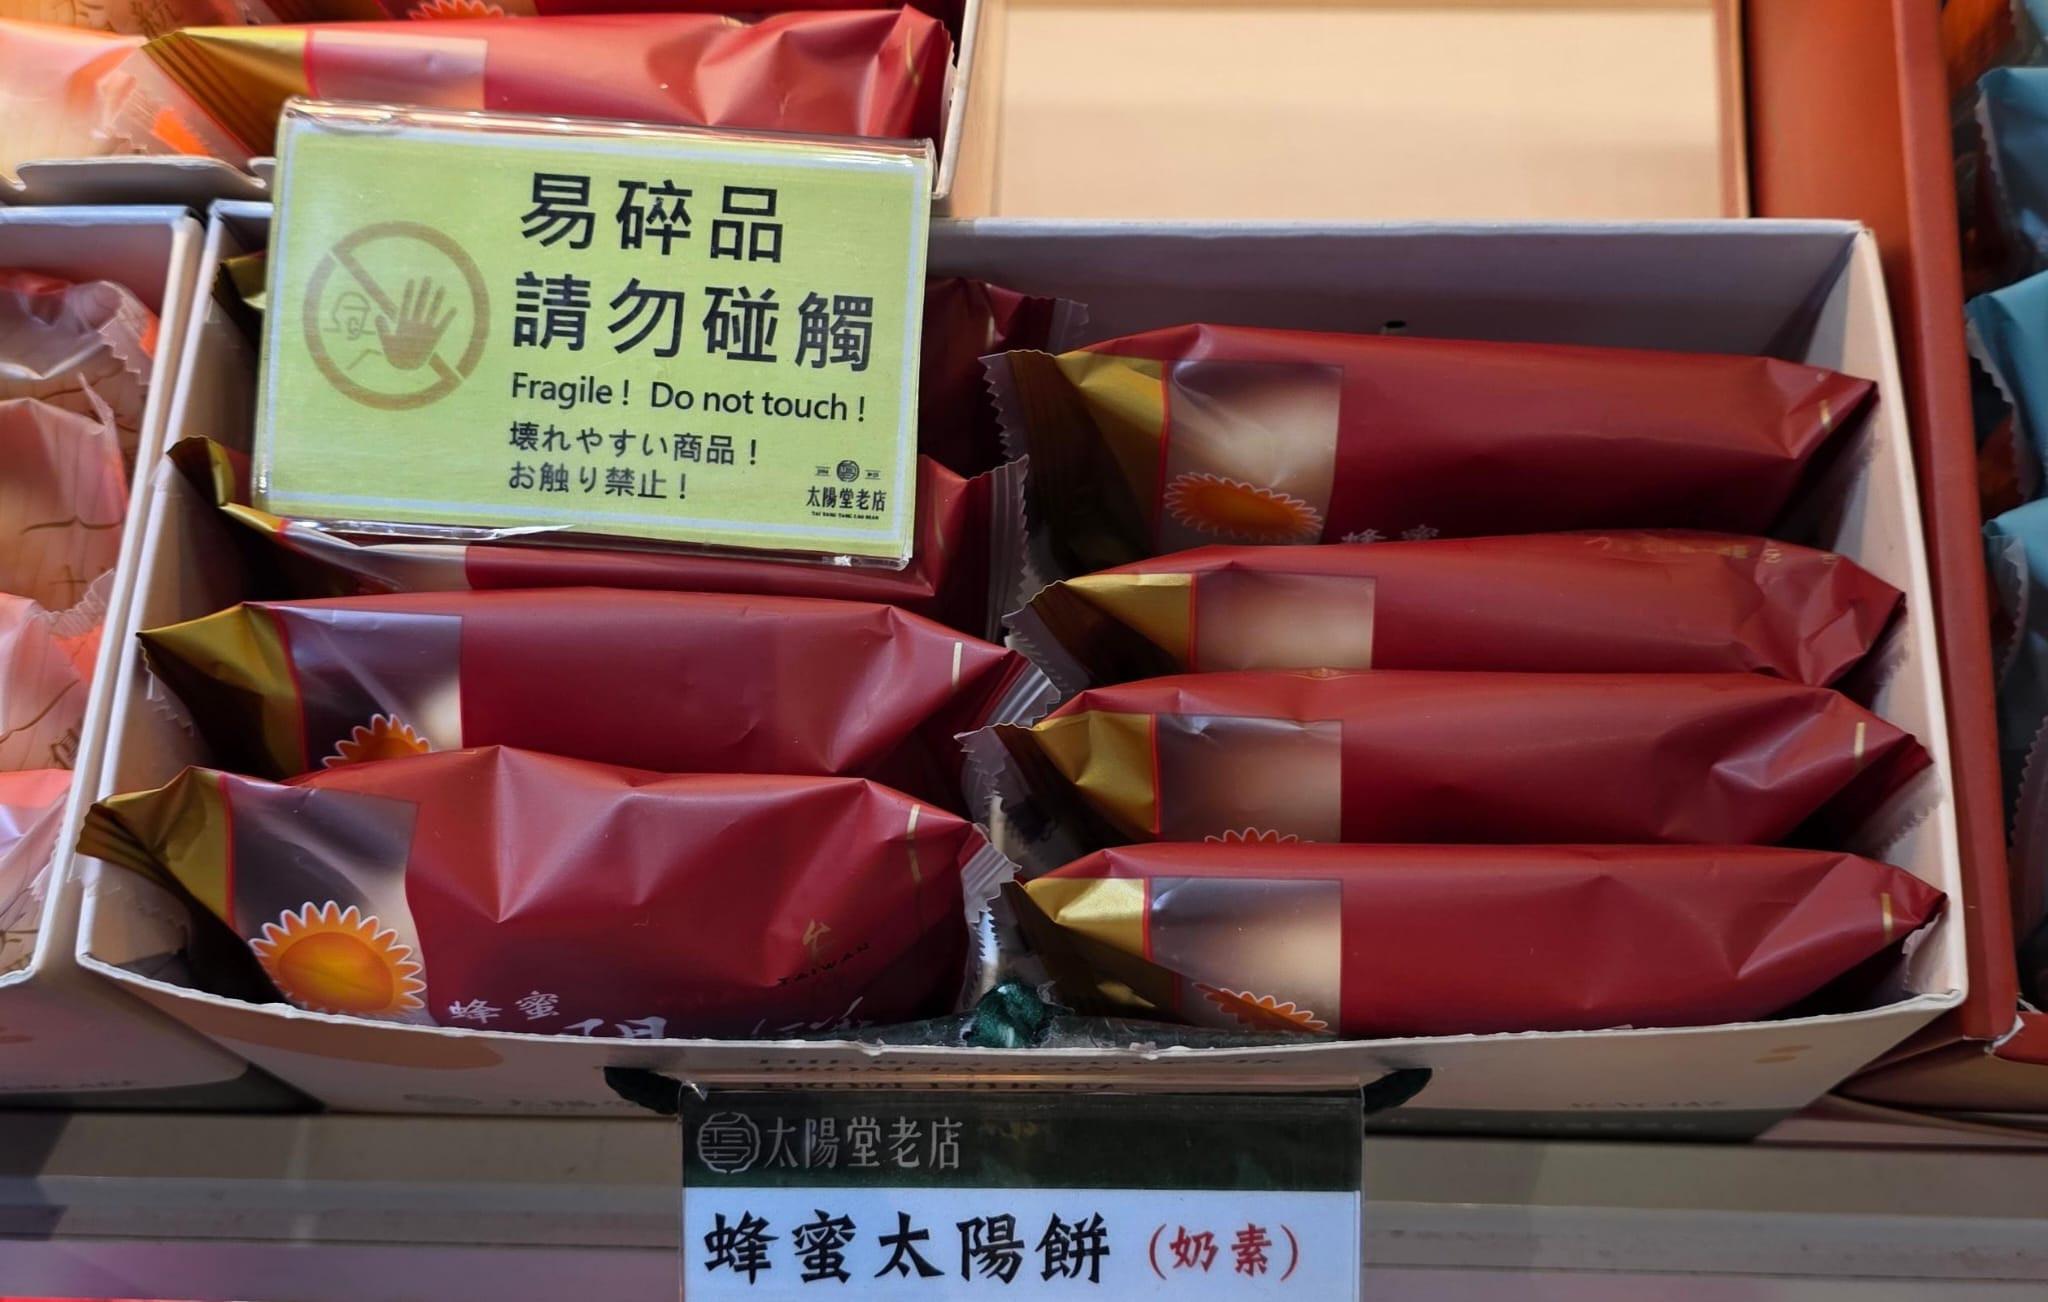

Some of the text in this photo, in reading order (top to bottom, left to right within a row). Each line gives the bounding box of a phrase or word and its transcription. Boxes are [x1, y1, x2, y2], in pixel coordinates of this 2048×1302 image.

[520, 172, 784, 263] 易碎品
[513, 271, 874, 373] 請勿碰觸
[651, 381, 695, 411] Do
[703, 389, 755, 415] not
[806, 485, 887, 511] 太陽堂老店
[765, 1116, 963, 1170] 太陽堂老店
[704, 1208, 1299, 1285] 蜂蜜太陽餅 (奶素)
